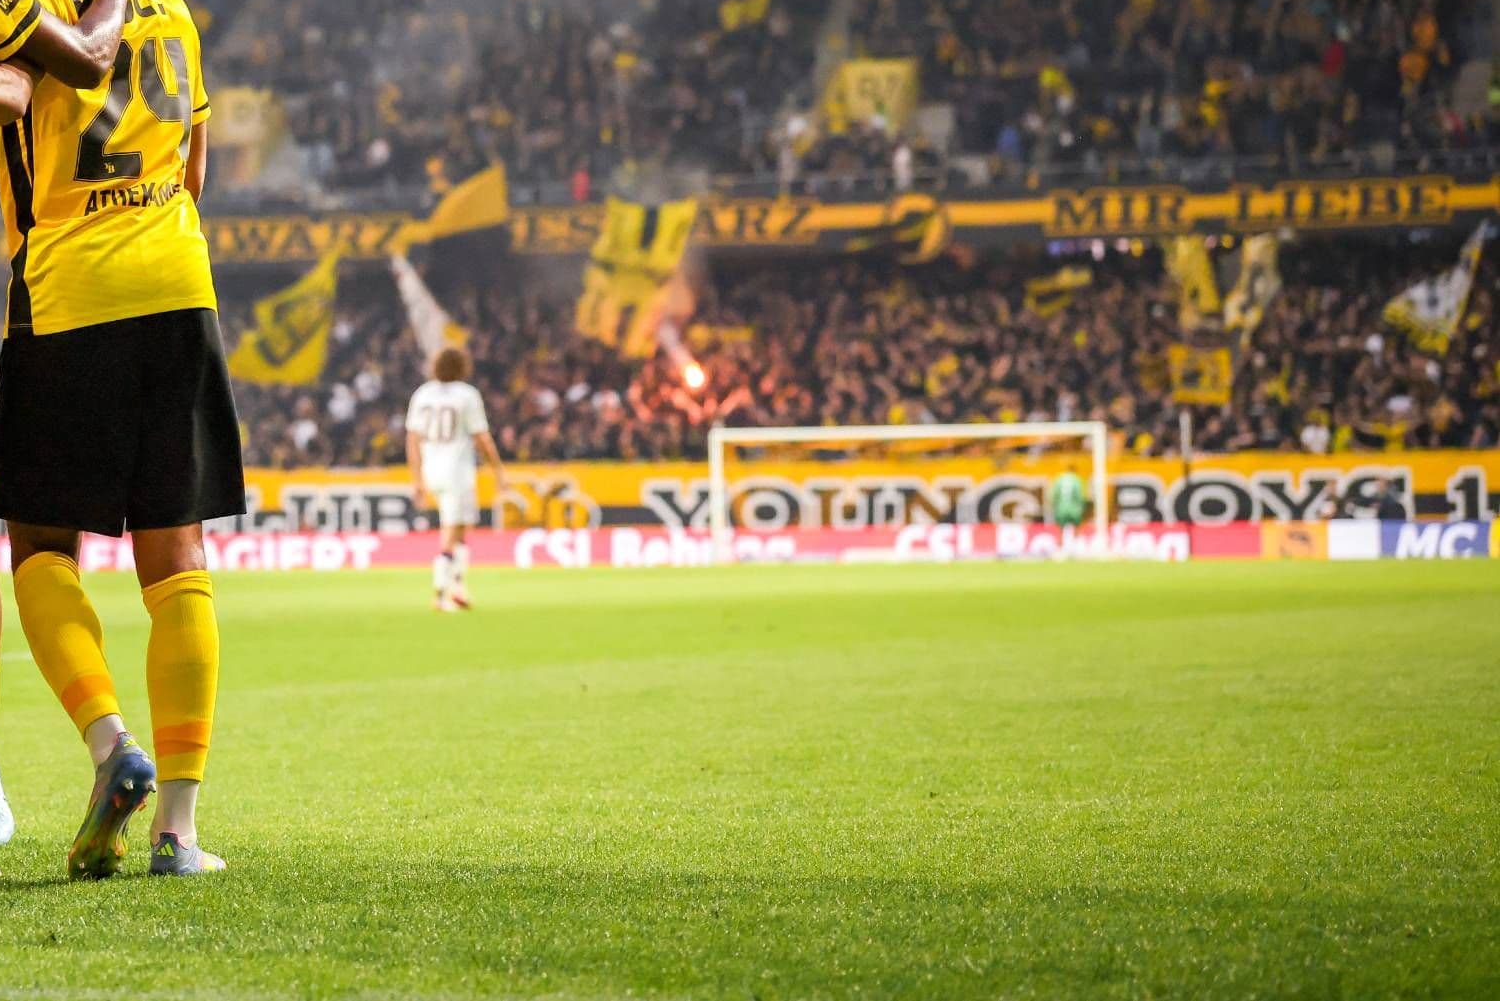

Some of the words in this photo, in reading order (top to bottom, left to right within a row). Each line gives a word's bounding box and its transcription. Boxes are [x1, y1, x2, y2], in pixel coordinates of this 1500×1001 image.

[1053, 190, 1188, 228] MIR
[1236, 180, 1450, 222] LIEBE
[644, 474, 1052, 530] YOUNG
[514, 528, 591, 568] CSL
